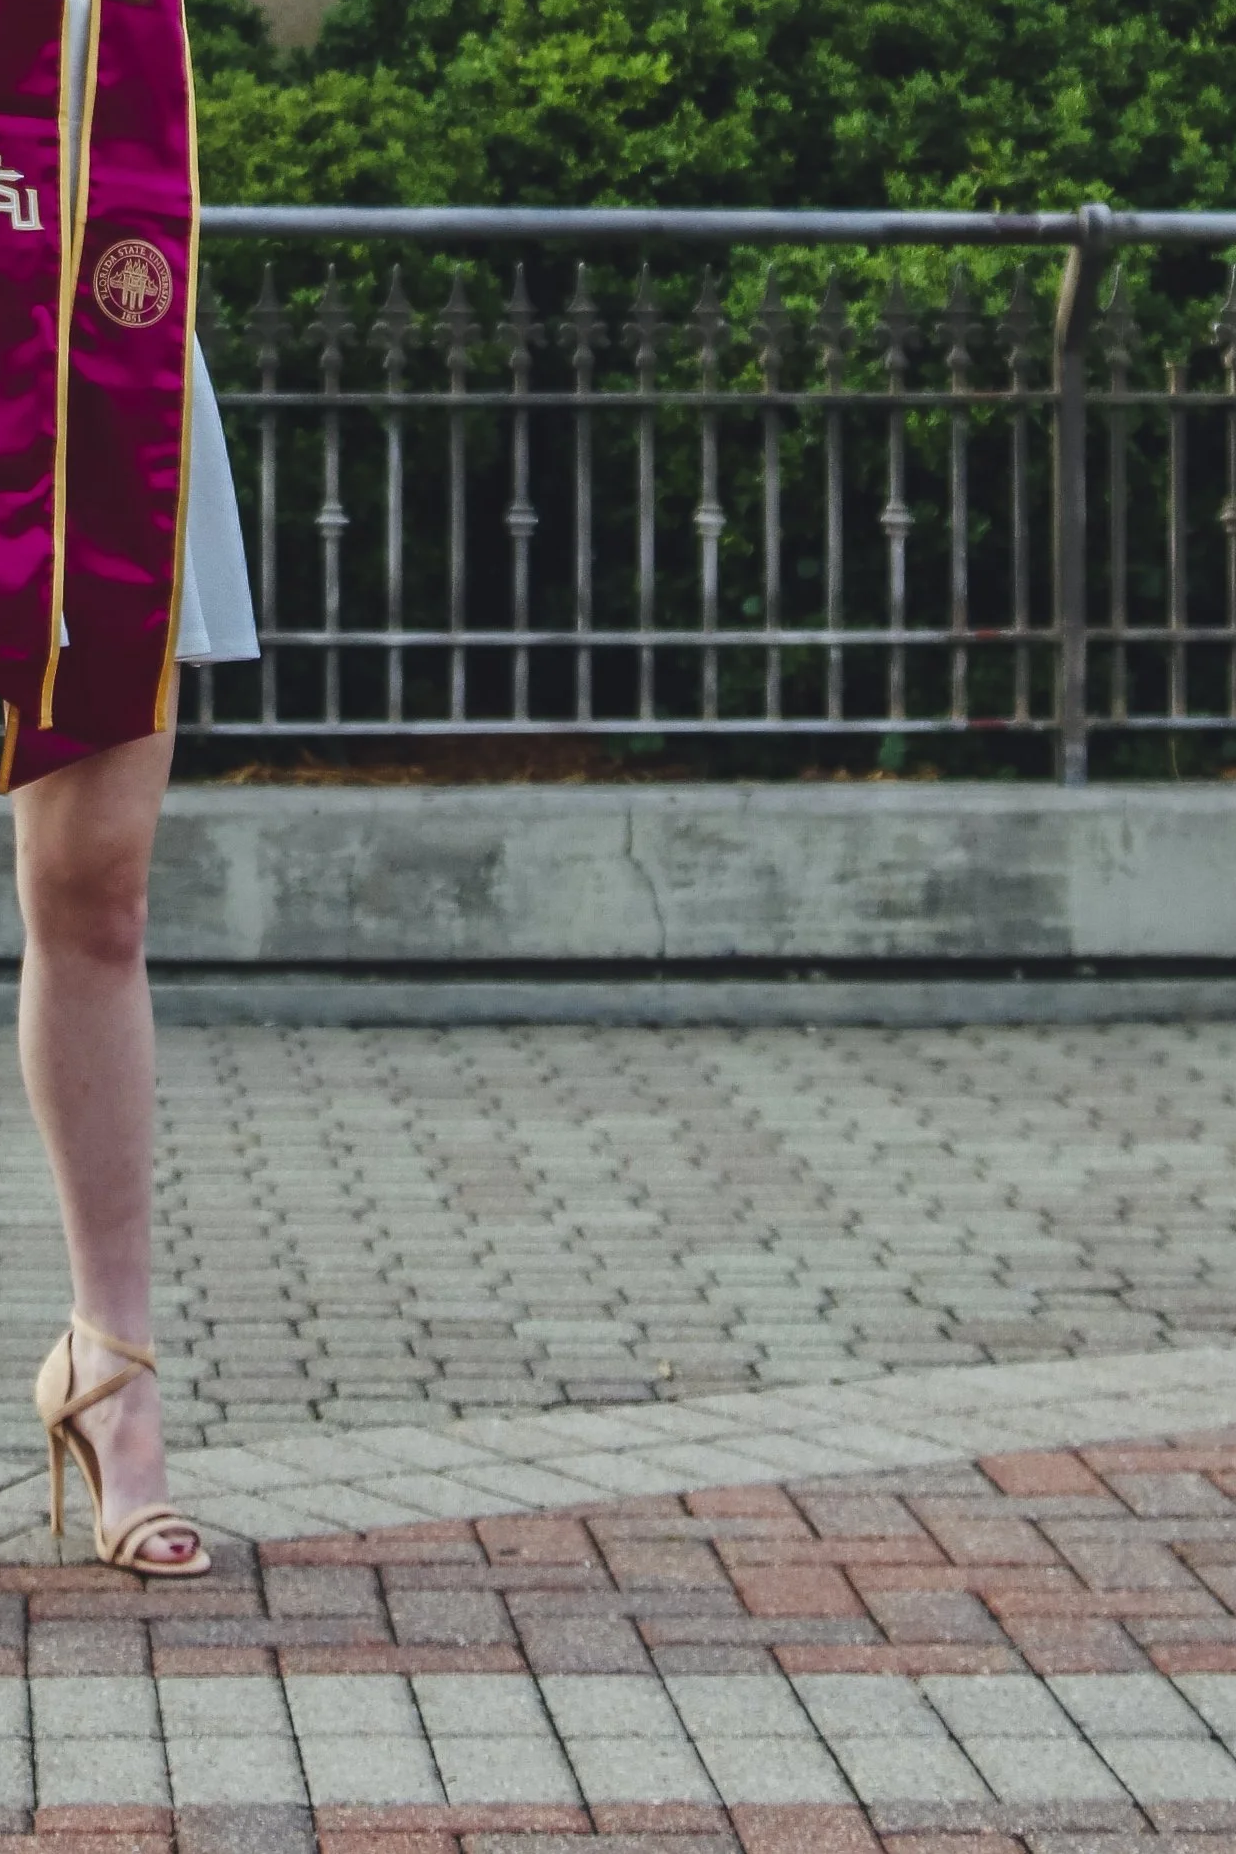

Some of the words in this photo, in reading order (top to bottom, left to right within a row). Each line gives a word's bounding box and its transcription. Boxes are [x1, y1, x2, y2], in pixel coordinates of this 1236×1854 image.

[98, 255, 117, 300] FLORIDA
[118, 245, 146, 256] STATE
[149, 252, 169, 312] UNIVERSITY
